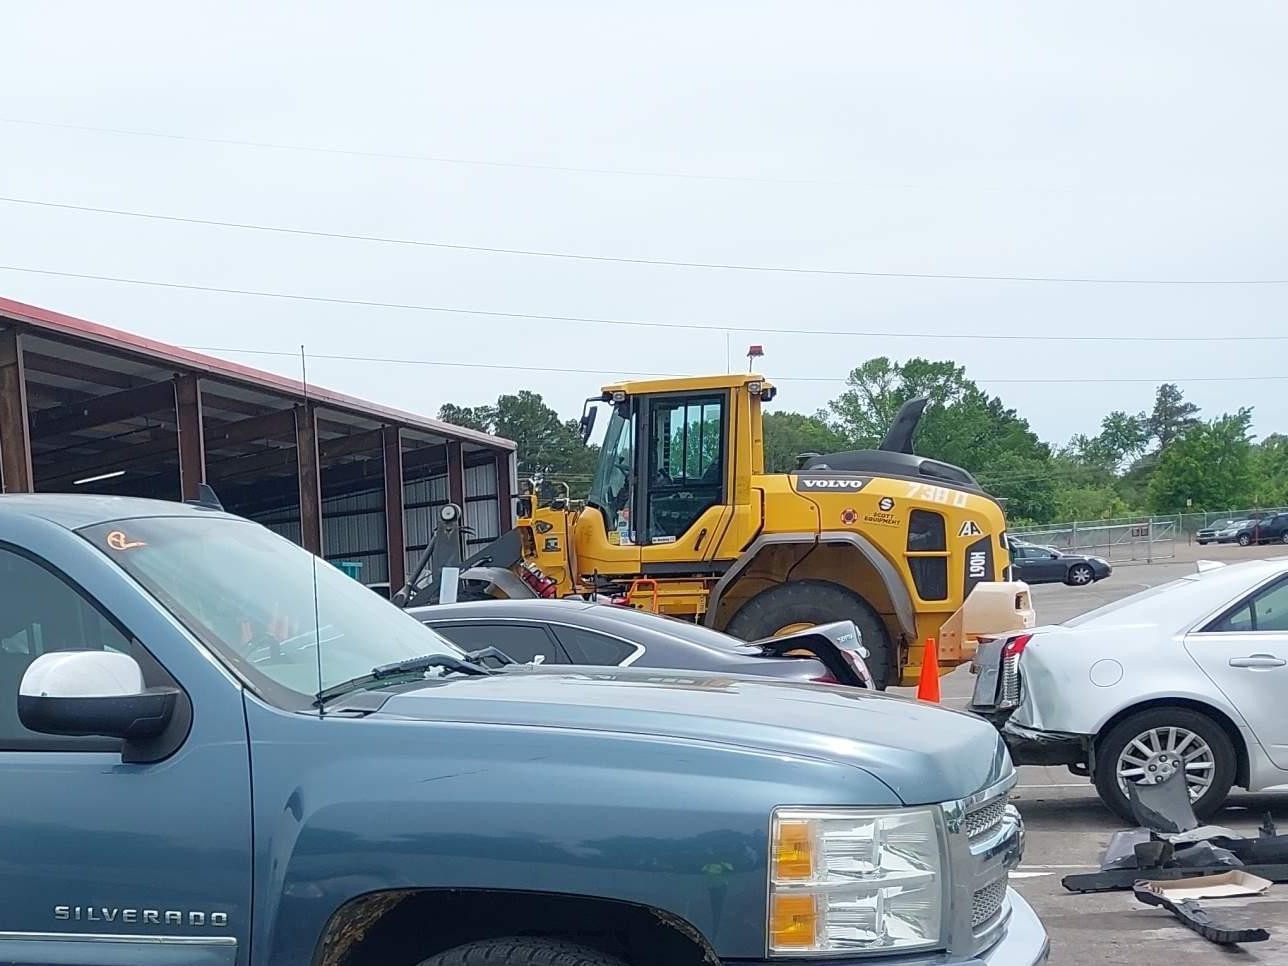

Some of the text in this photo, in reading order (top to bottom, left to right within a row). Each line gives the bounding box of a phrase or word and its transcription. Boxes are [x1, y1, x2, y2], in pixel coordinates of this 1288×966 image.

[803, 479, 863, 488] VOLVO
[864, 515, 901, 525] EQUIPMENT
[969, 551, 986, 578] L90H
[54, 906, 228, 927] SILVERADO
